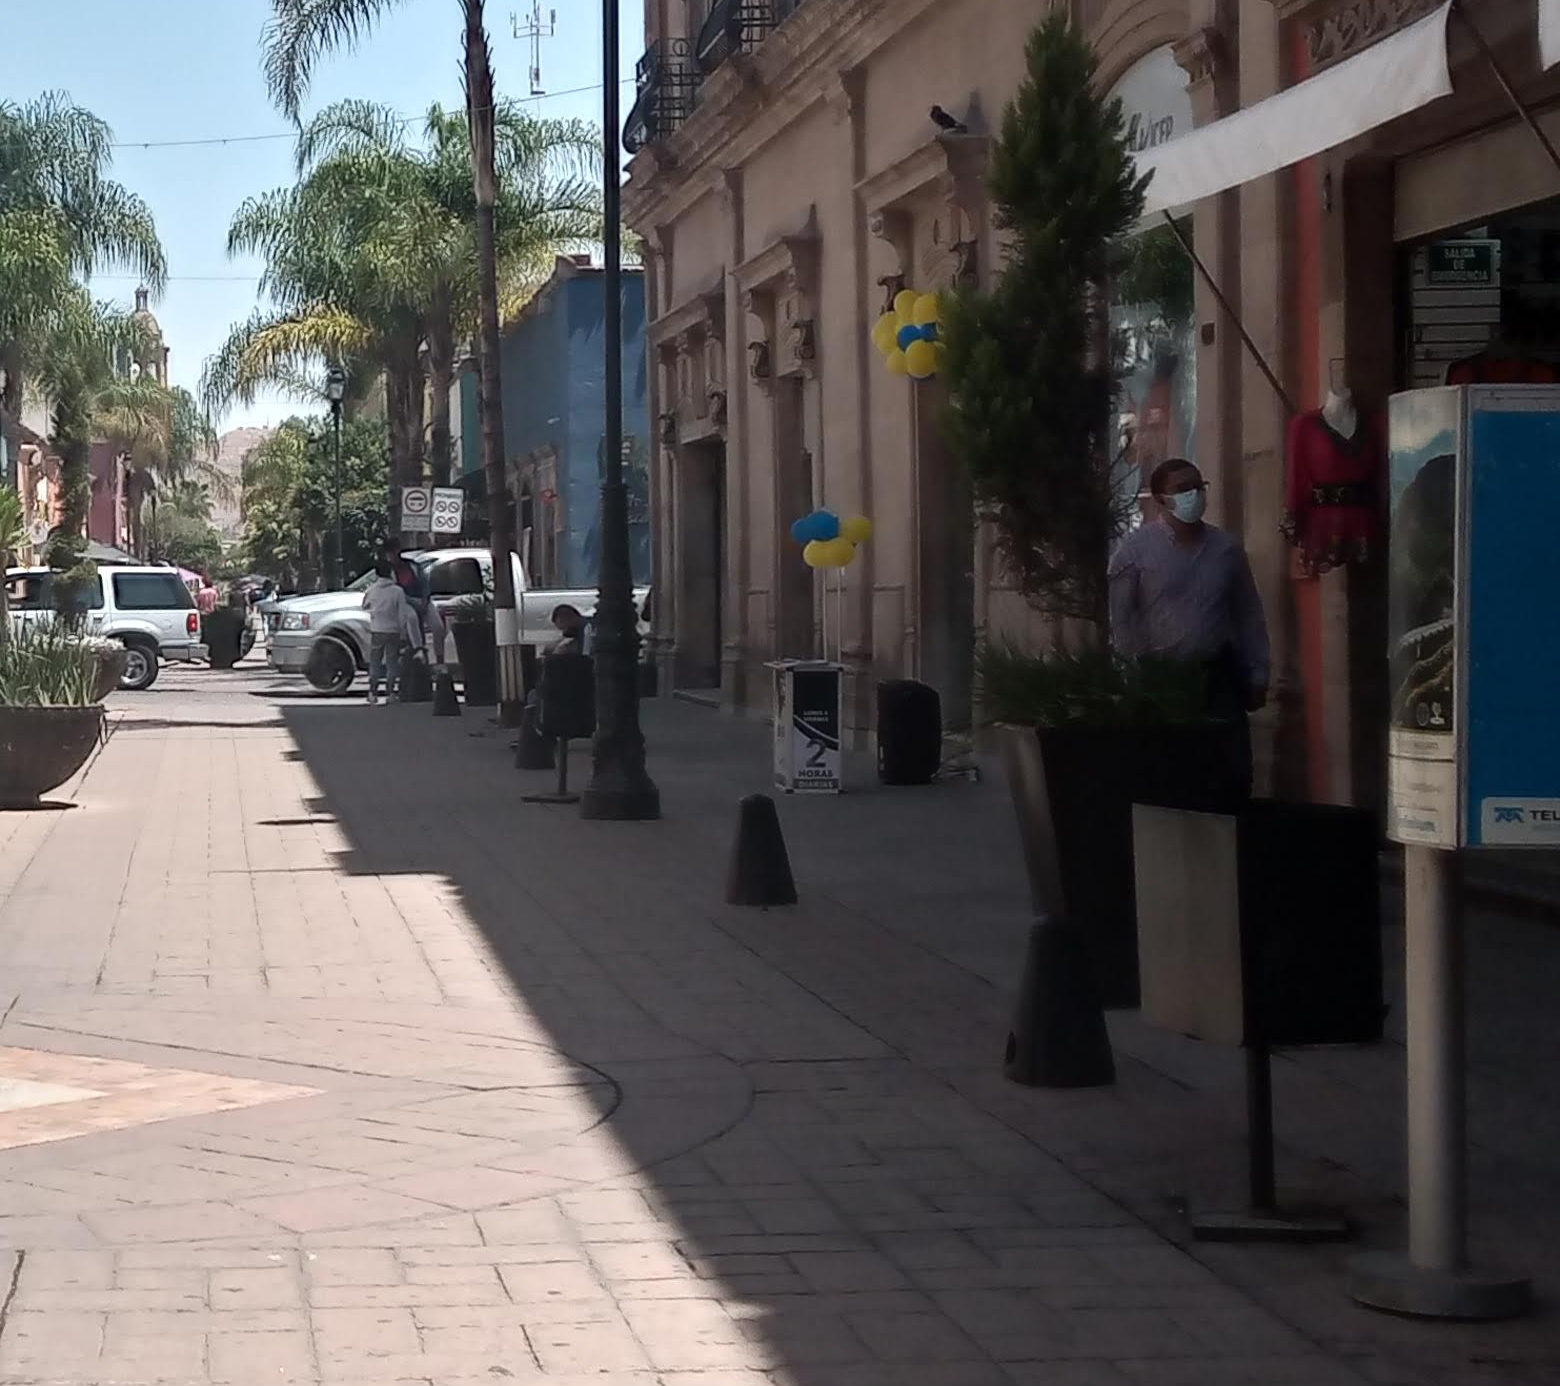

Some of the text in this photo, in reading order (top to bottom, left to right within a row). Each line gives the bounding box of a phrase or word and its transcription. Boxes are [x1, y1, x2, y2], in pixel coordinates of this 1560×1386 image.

[1444, 248, 1476, 259] SALIDA
[806, 738, 827, 768] 2
[798, 770, 833, 778] HORAS
